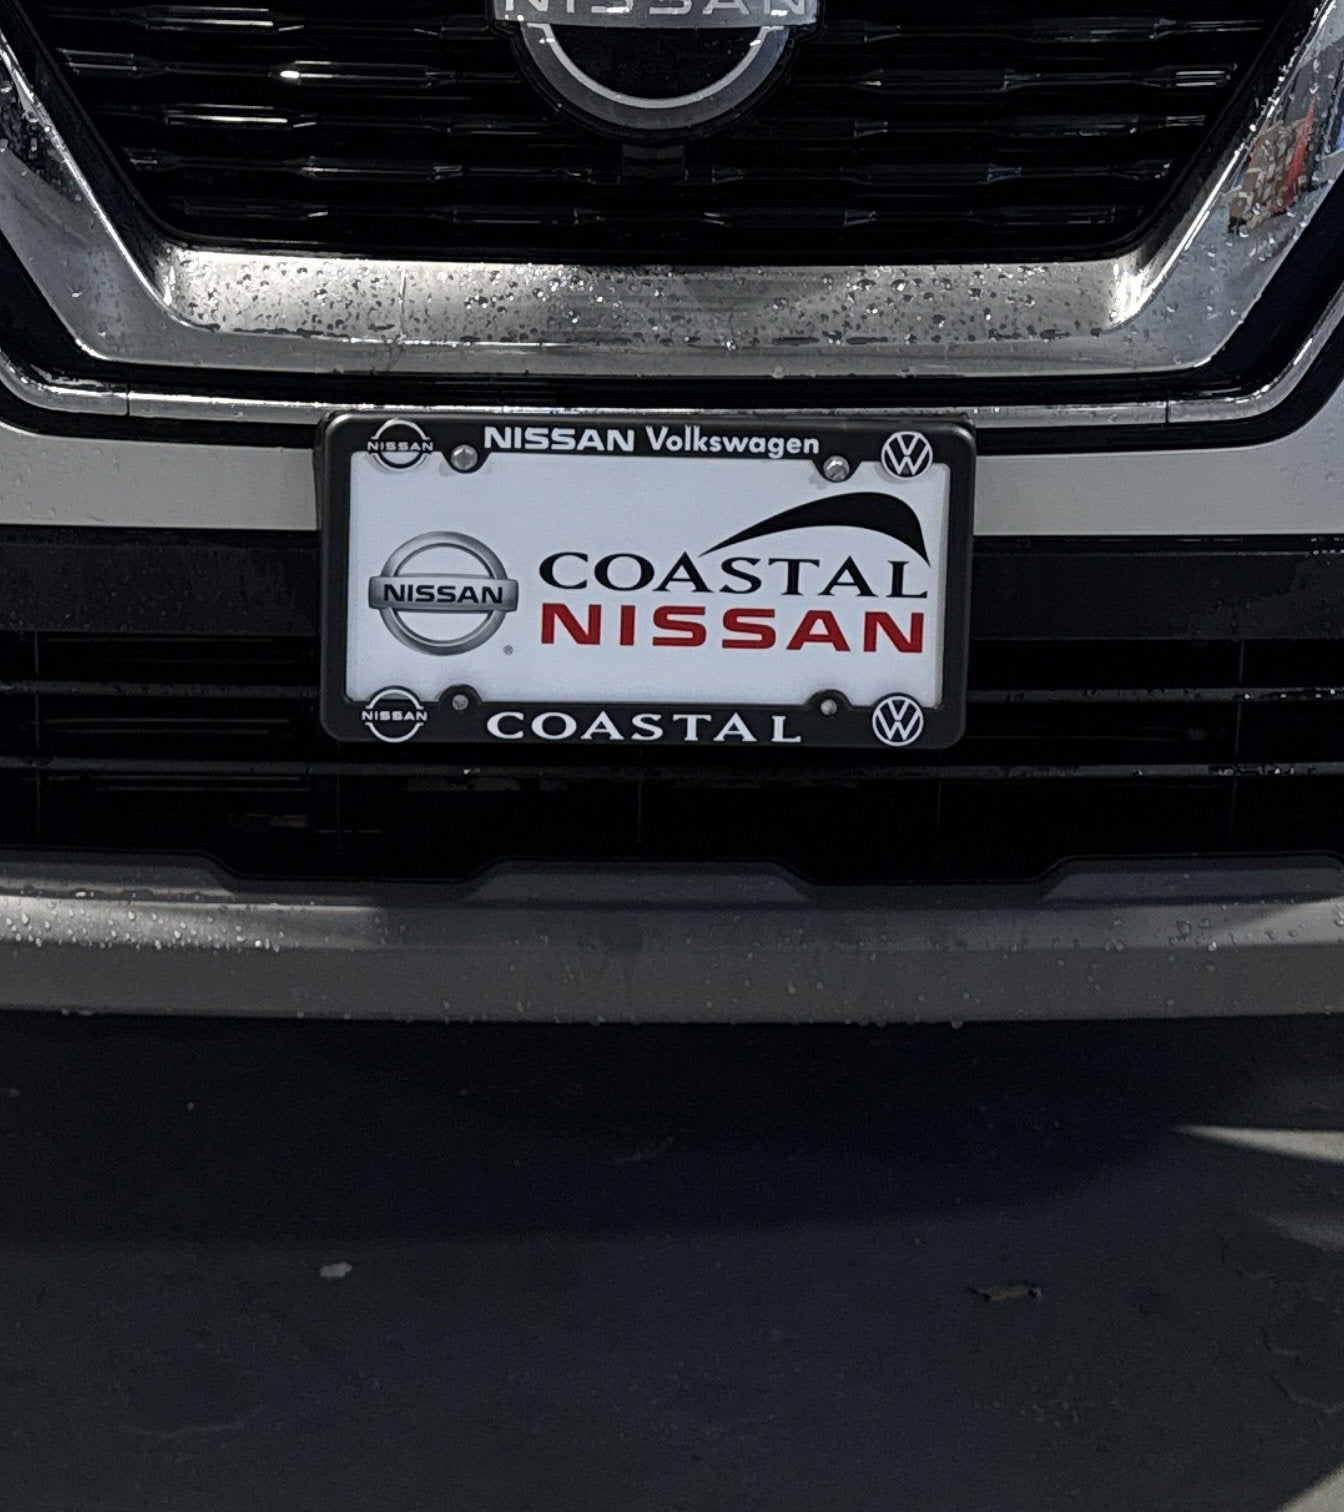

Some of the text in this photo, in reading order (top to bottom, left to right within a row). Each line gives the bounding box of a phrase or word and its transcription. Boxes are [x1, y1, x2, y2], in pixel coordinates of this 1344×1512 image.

[367, 441, 434, 452] NISSAN
[484, 424, 820, 459] NISSAN Volkswagen
[538, 550, 929, 599] COASTAL
[382, 582, 504, 605] NISSAN
[540, 602, 925, 654] NISSAN
[361, 710, 428, 722] NISSAN
[486, 710, 802, 743] COASTAL
